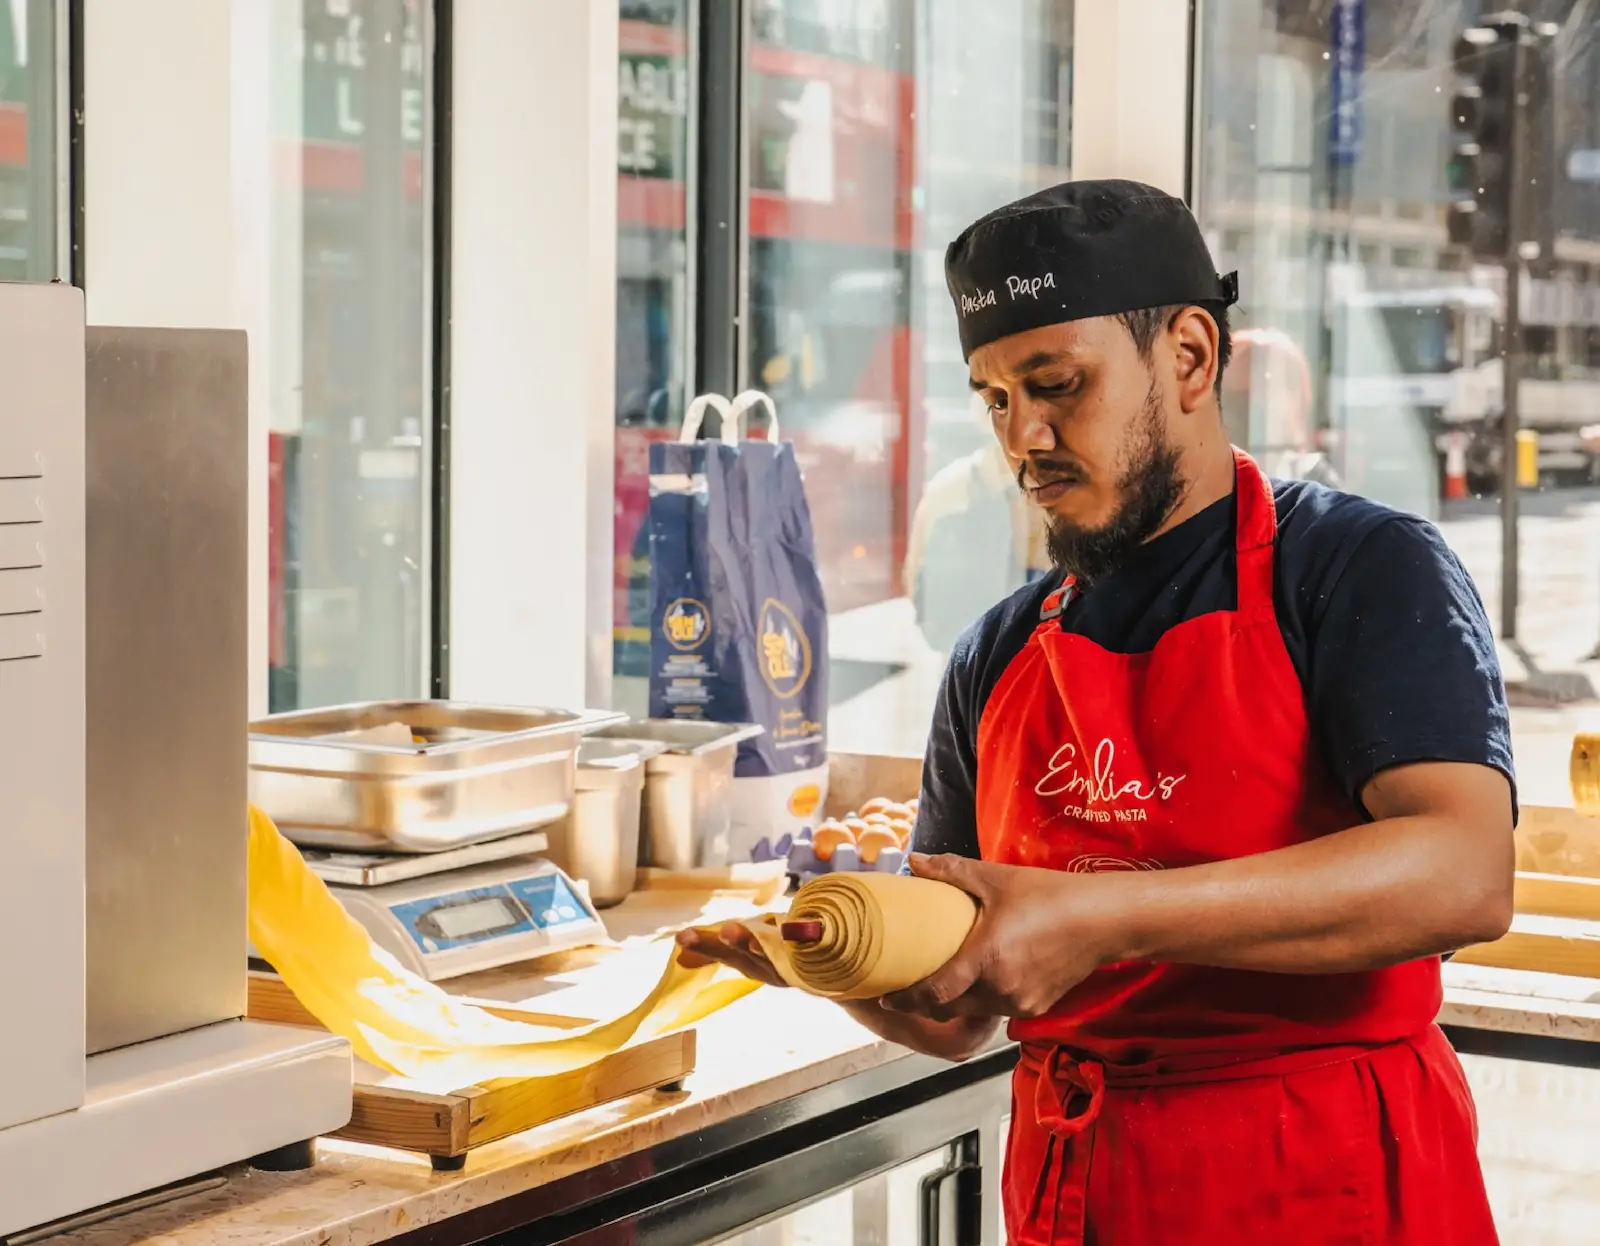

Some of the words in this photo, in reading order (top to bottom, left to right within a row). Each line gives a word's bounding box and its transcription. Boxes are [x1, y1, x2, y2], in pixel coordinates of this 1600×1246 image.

[960, 287, 997, 318] Pasta
[1005, 271, 1057, 301] Papa
[1113, 808, 1148, 823] PASTA
